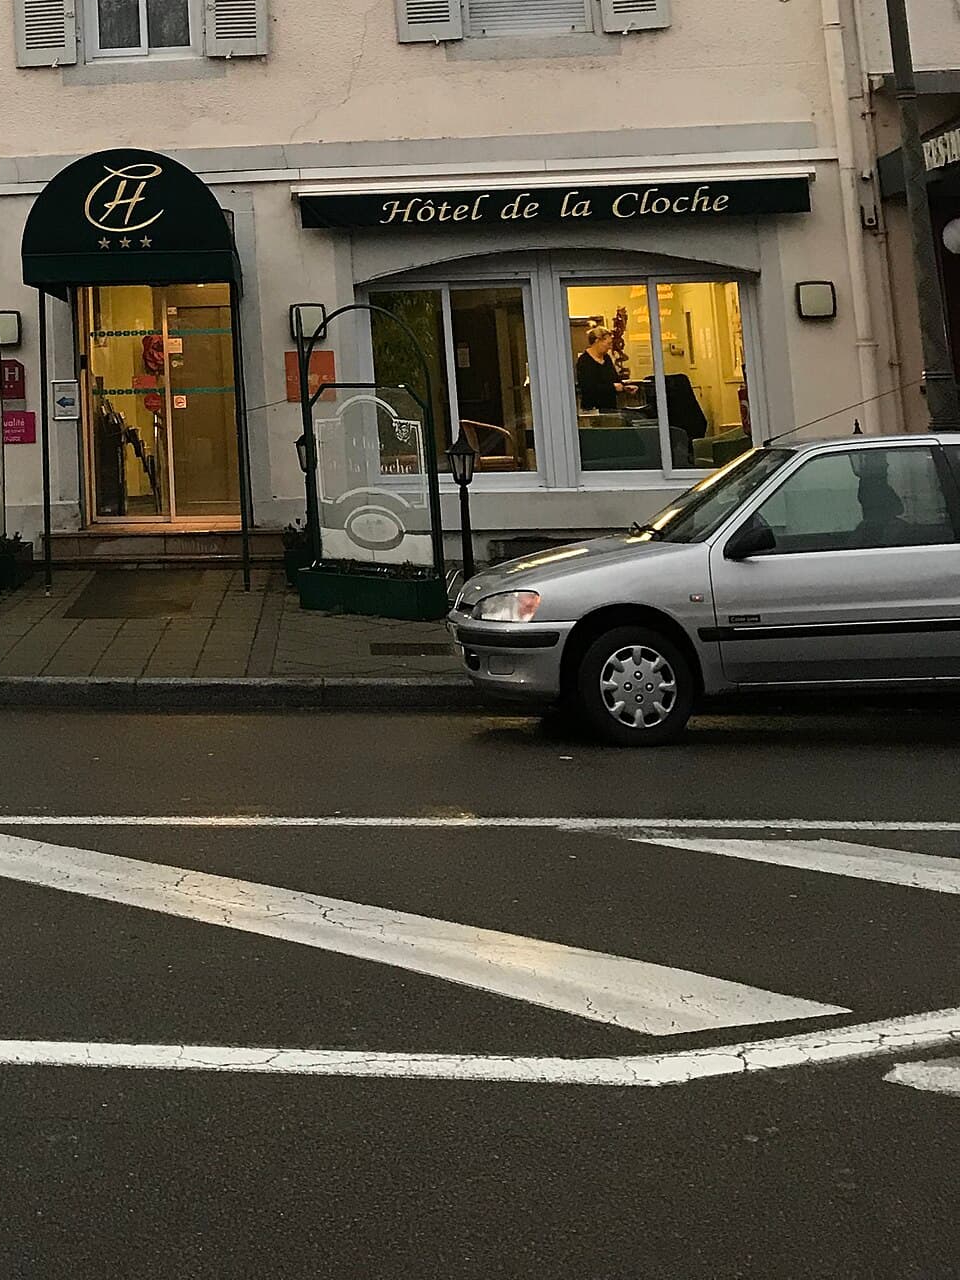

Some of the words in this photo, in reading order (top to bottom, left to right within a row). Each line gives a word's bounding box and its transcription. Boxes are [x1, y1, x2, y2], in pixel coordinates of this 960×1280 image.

[379, 194, 490, 224] Hôtel
[500, 193, 539, 220] de
[560, 191, 592, 218] la
[612, 186, 730, 218] Cloche
[4, 366, 20, 382] H
